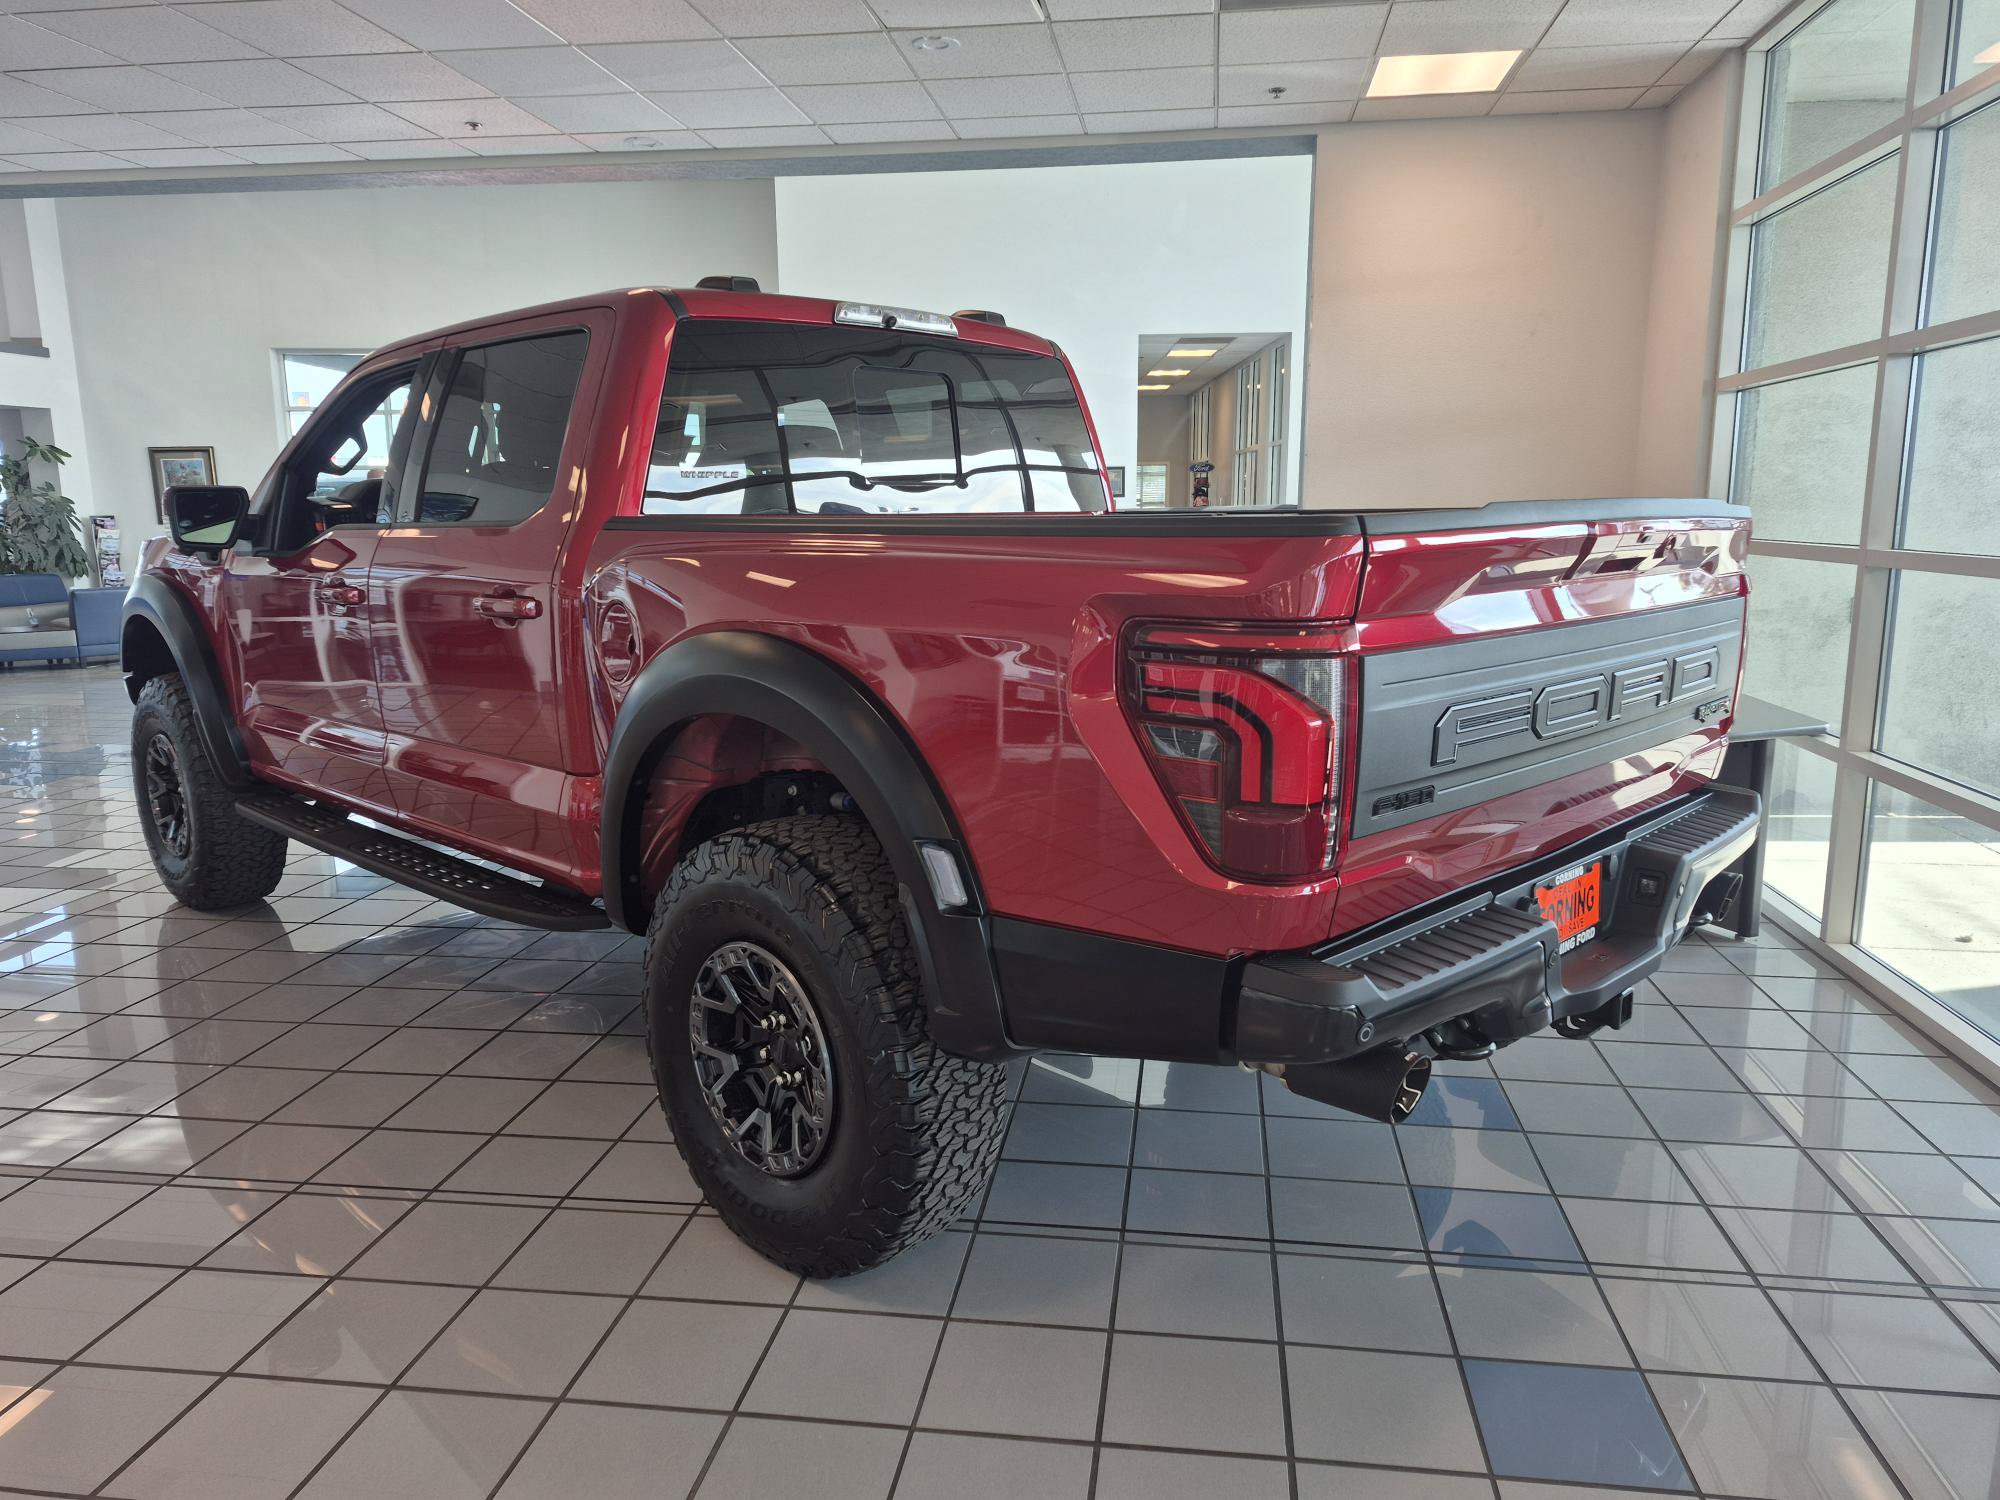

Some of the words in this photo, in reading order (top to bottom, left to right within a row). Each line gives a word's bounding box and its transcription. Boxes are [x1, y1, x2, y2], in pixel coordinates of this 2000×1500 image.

[680, 470, 739, 479] WHIPPLE
[1430, 646, 1722, 767] FORD
[1555, 865, 1584, 886] CORNING
[1576, 926, 1596, 946] FORD
